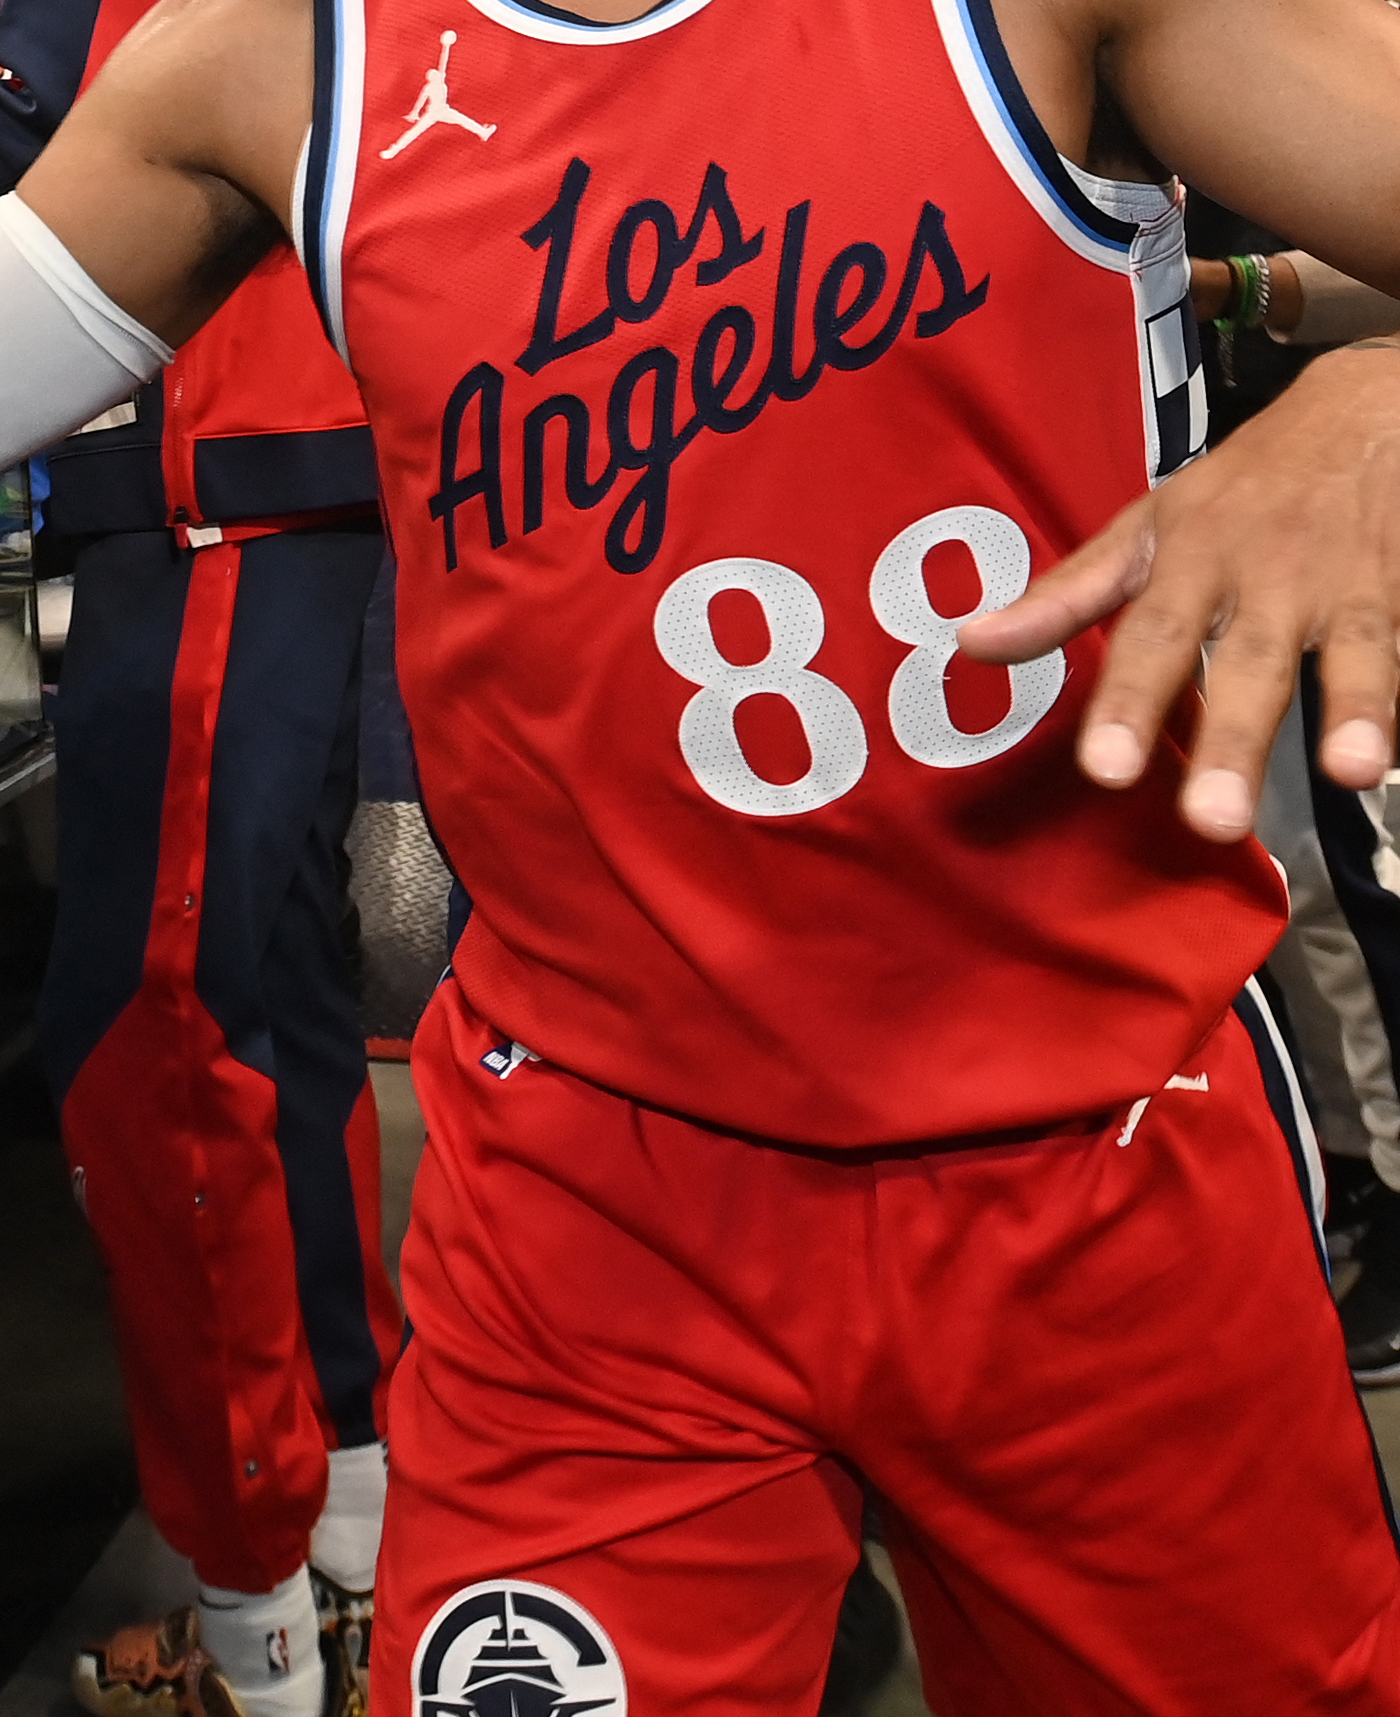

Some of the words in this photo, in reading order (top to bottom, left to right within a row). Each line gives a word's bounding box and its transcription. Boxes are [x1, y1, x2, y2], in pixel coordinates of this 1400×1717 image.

[428, 199, 991, 576] Angeles
[515, 157, 766, 377] Los
[652, 504, 1067, 818] 88
